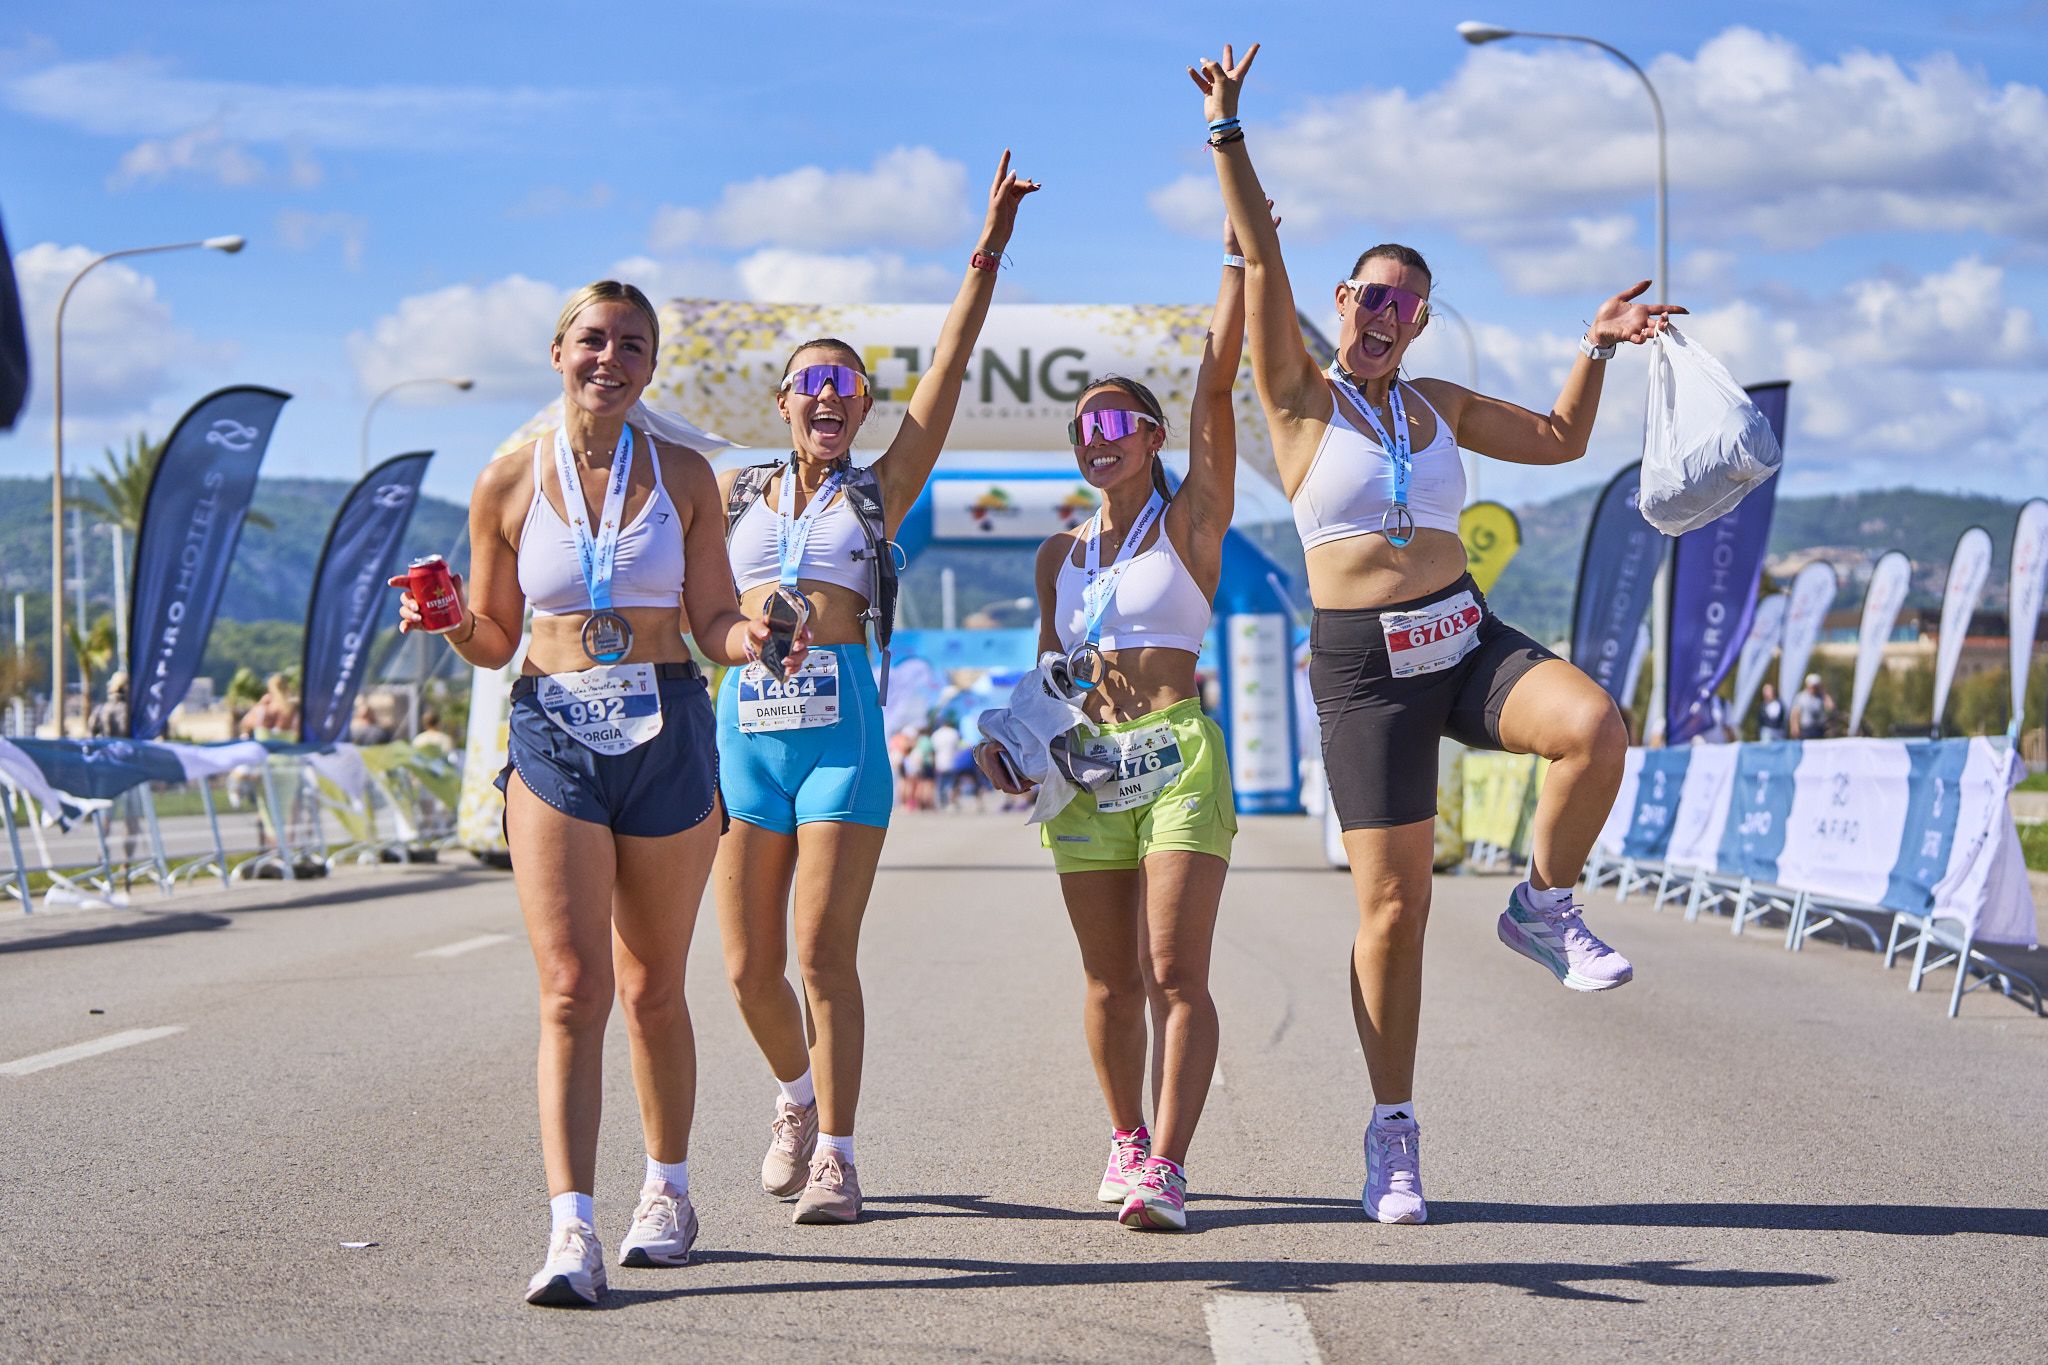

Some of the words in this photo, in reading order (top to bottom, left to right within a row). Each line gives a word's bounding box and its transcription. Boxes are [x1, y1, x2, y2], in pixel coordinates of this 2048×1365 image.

[931, 347, 1089, 404] NG
[613, 464, 626, 496] Marathon
[176, 472, 225, 592] HOTELS
[426, 594, 455, 609] ESTRELLA
[1408, 612, 1468, 647] 6703
[753, 676, 817, 701] 1464
[569, 697, 627, 727] 992
[756, 704, 807, 718] DANIELLE
[573, 728, 623, 742] ORGIA
[1119, 783, 1142, 797] ANN
